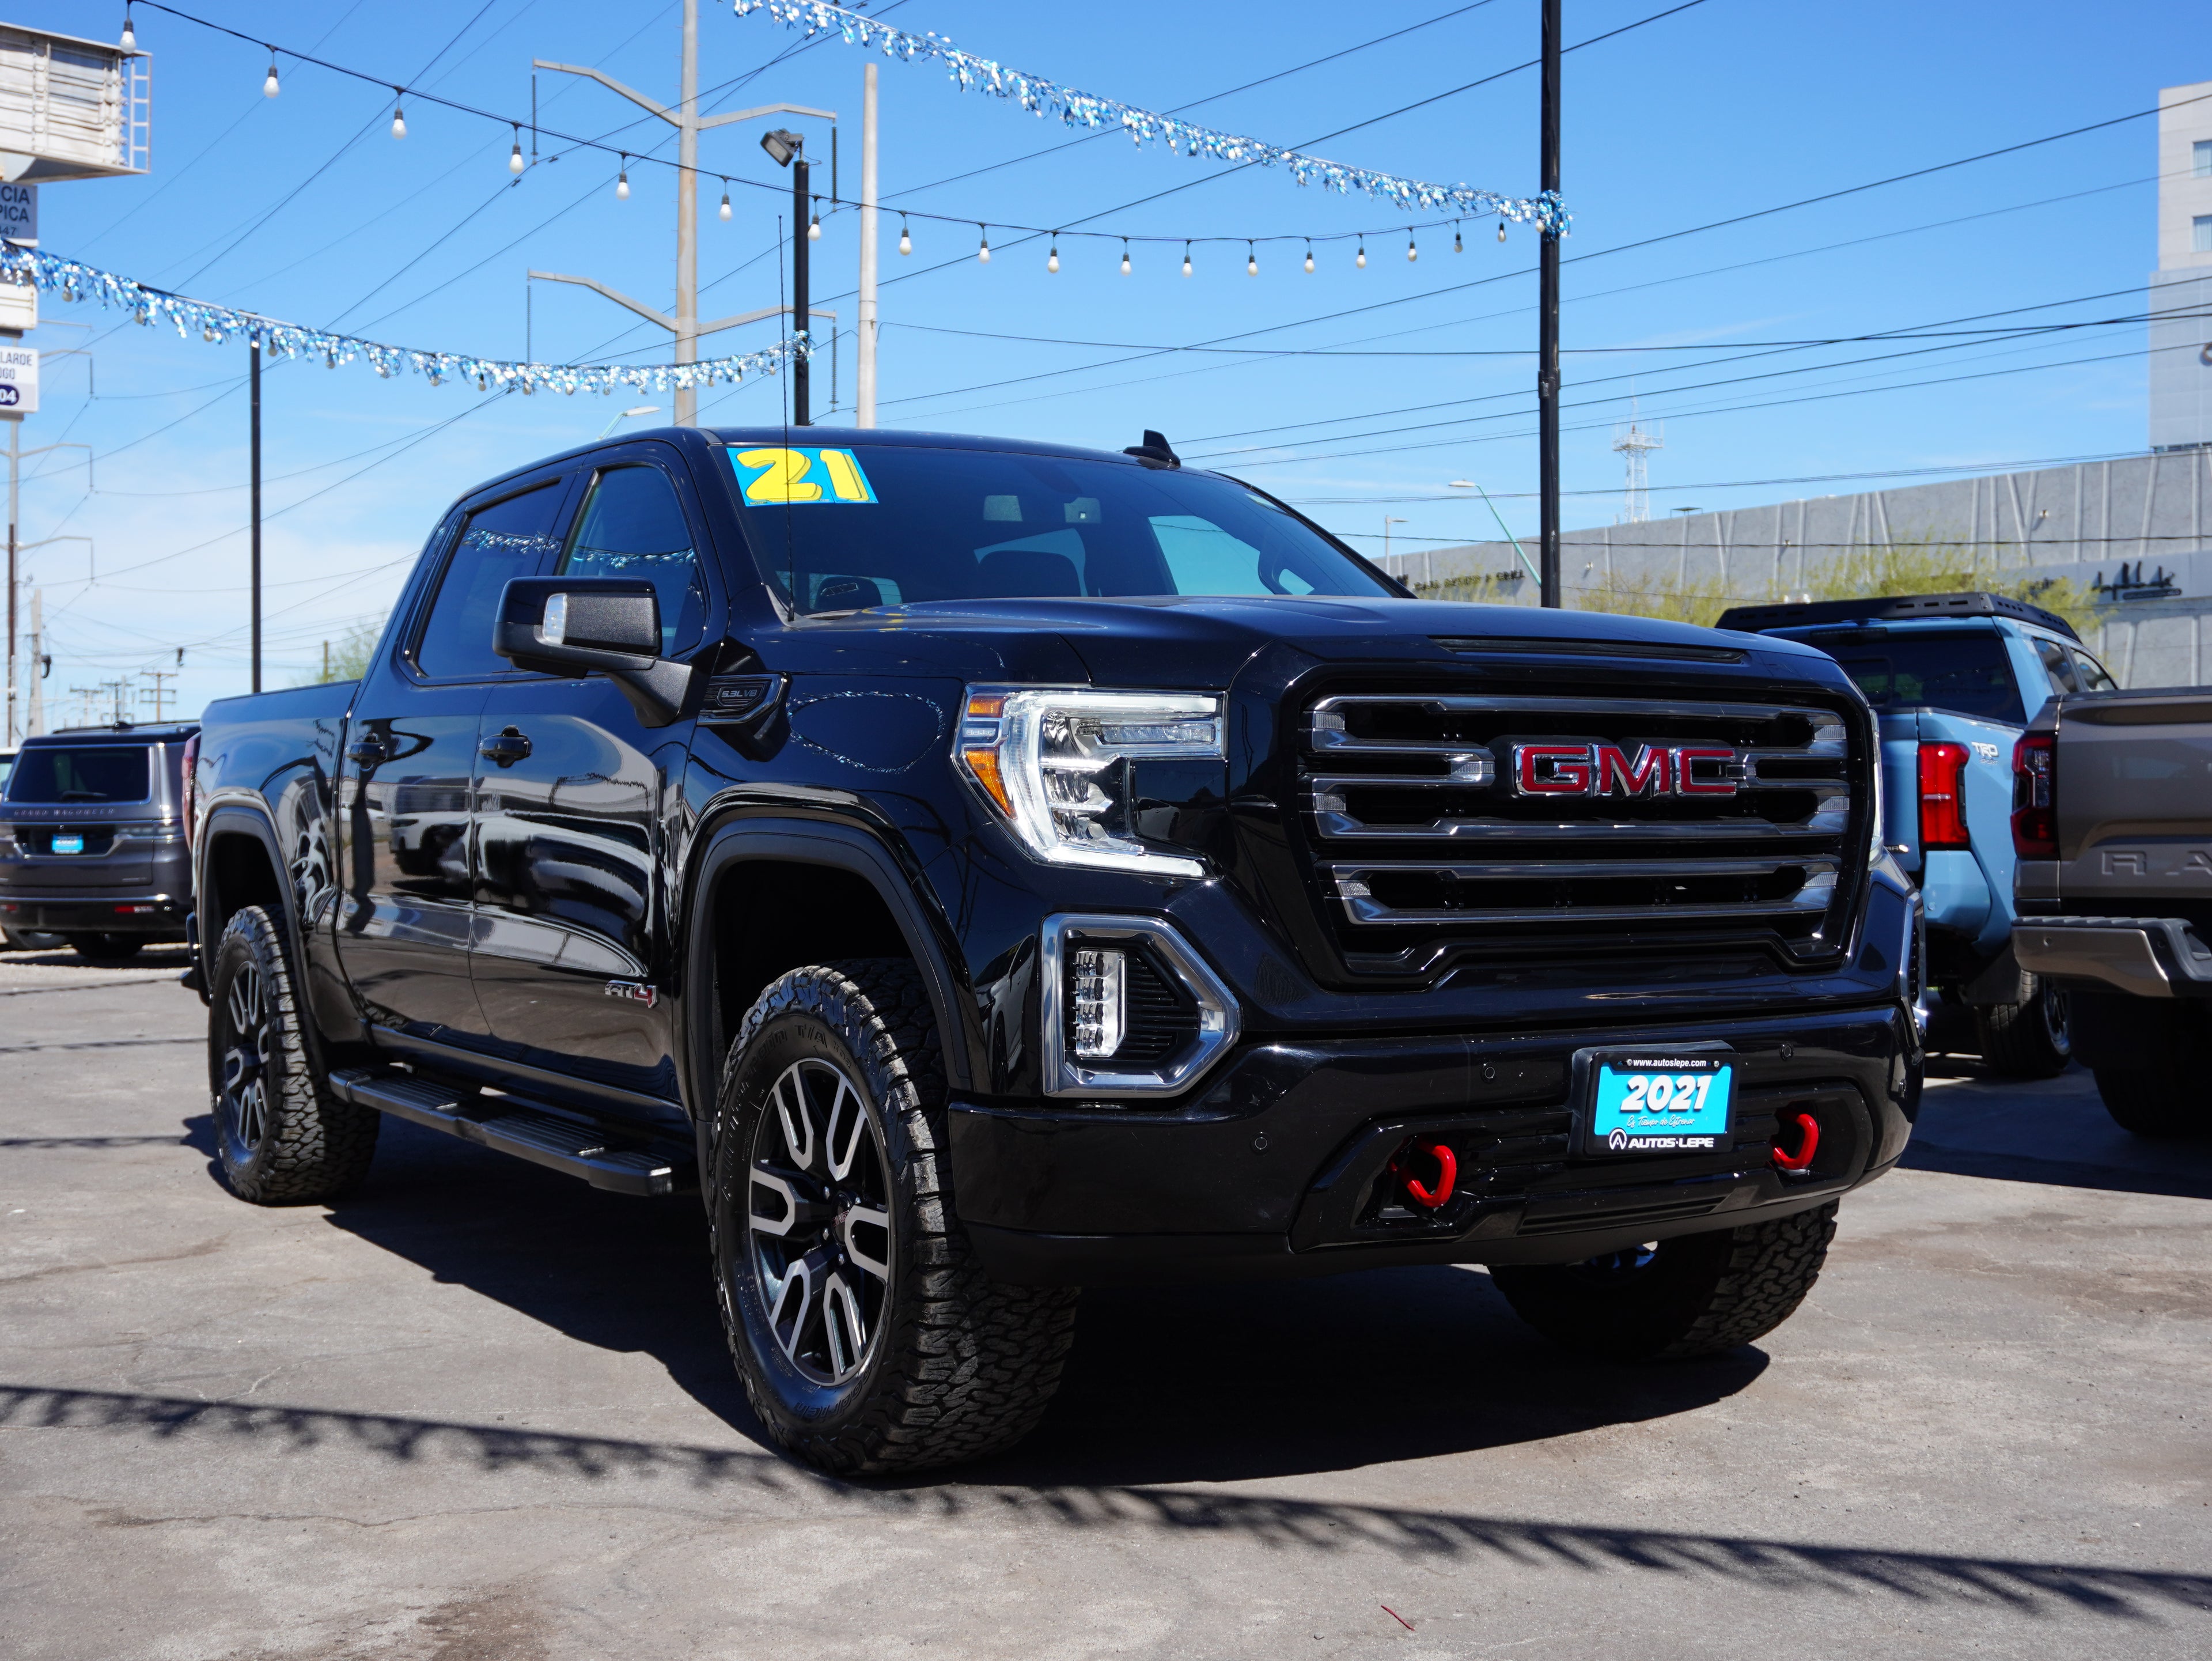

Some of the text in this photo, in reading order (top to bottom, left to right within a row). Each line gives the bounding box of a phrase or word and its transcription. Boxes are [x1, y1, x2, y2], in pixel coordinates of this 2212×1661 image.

[1, 186, 30, 205] CIA
[736, 448, 869, 502] 21
[1971, 741, 1999, 758] TRD
[1513, 743, 1737, 798] GMC
[14, 808, 115, 816] GRAND WAGONEER
[605, 979, 657, 1008] AT4
[1633, 1058, 1707, 1069] www.autoslepe.com
[1620, 1075, 1713, 1112] 2021
[1627, 1115, 1636, 1128] Es
[1660, 1117, 1668, 1126] de
